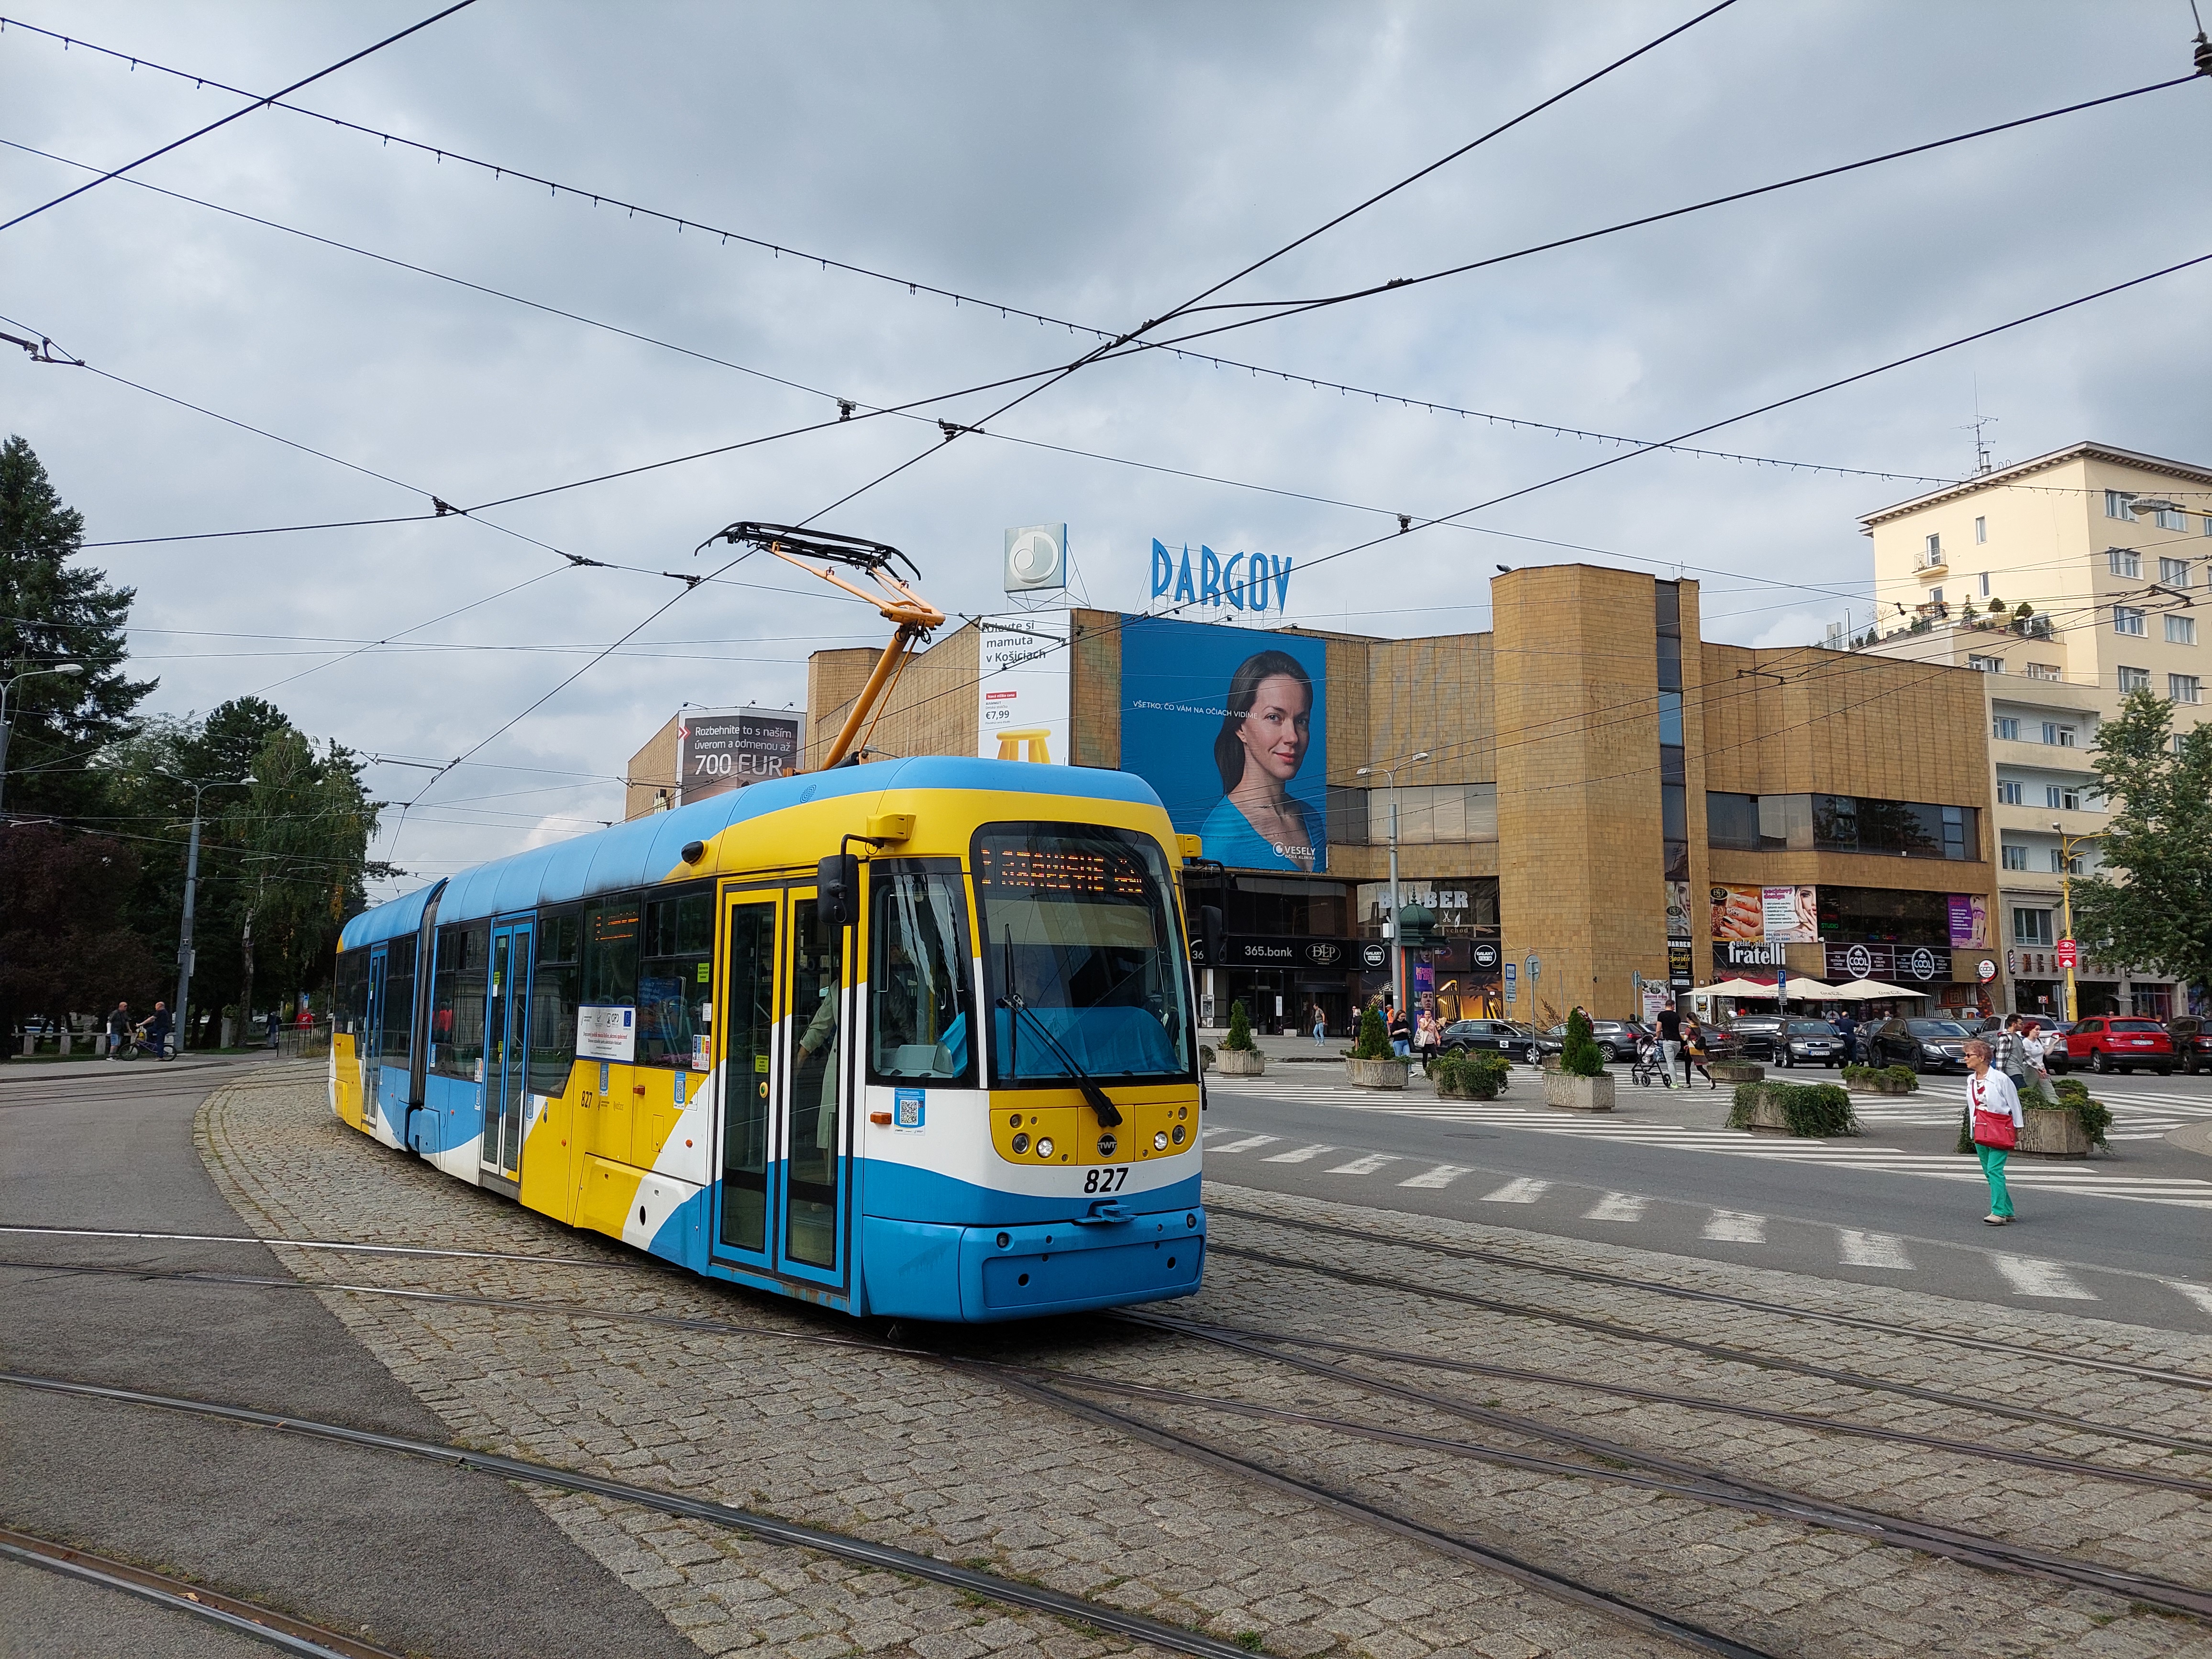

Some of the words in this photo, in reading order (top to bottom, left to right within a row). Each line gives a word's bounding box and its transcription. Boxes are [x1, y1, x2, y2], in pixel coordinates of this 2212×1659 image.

[1152, 537, 1293, 615] DARGOV
[1026, 621, 1035, 630] si
[986, 636, 1033, 648] mamuta
[995, 650, 1046, 663] Košiciach
[985, 710, 1009, 720] €7,99
[1133, 700, 1162, 710] VŠETKO,
[1164, 702, 1175, 710] ČO
[1176, 705, 1192, 713] VÁM
[1206, 707, 1232, 717] OČIACH
[1234, 710, 1258, 719] VIDÍME
[695, 724, 740, 736] Rozbehnite
[742, 725, 752, 734] to
[763, 727, 792, 739] naším
[695, 739, 726, 750] úverom
[735, 739, 778, 751] odmenou
[780, 741, 791, 752] až
[695, 754, 731, 775] 700
[738, 753, 783, 777] EUR
[1284, 845, 1316, 856] VESELY
[1245, 946, 1293, 957] 365.bank
[1669, 951, 1691, 964] Sparkle
[1728, 940, 1786, 965] fratelli
[1849, 957, 1869, 966] COOL
[1914, 959, 1932, 968] COOL
[1780, 972, 1784, 983] P
[581, 1090, 593, 1109] 827
[1084, 1167, 1129, 1194] 827
